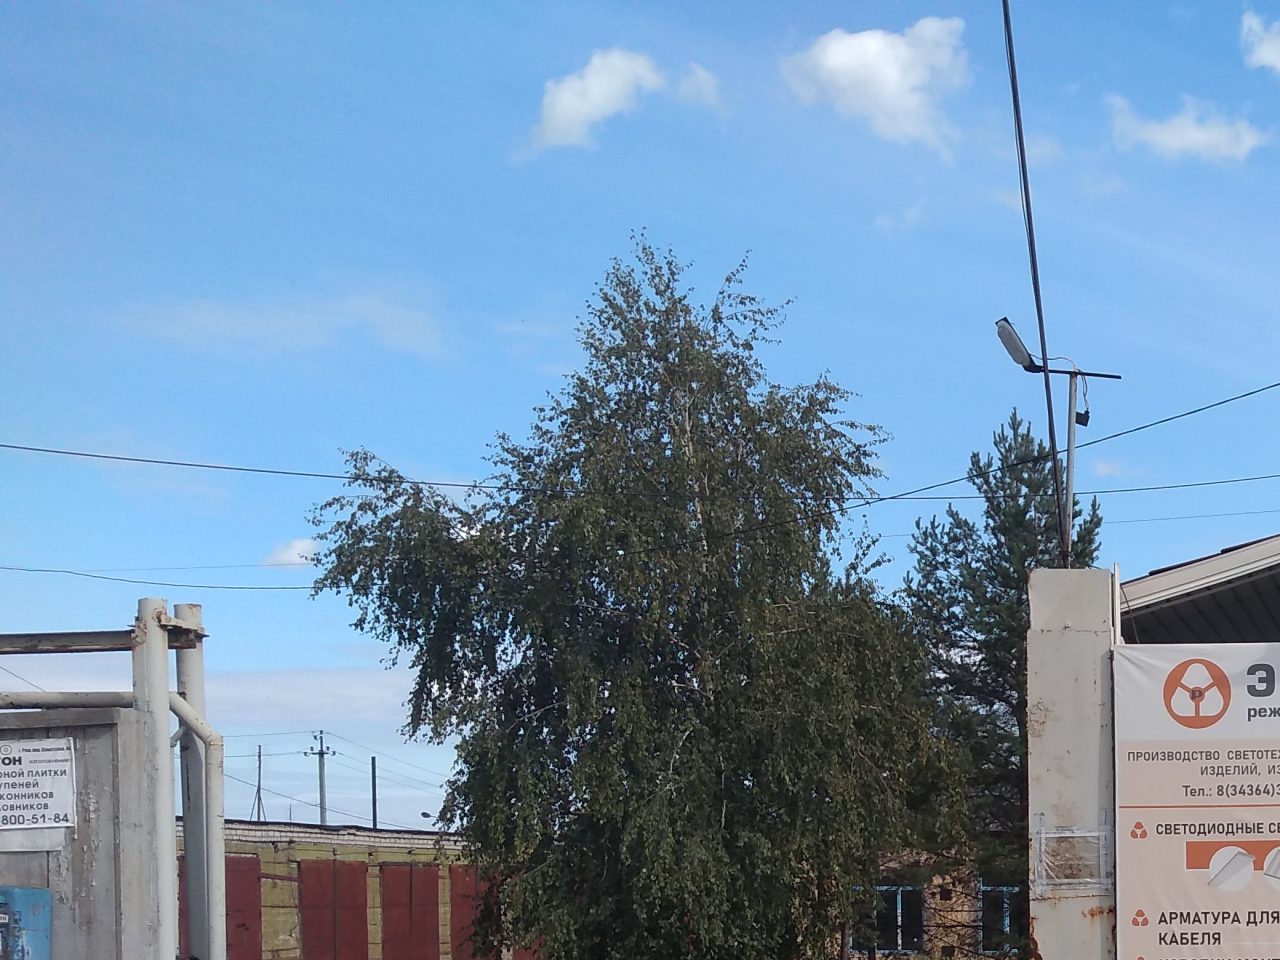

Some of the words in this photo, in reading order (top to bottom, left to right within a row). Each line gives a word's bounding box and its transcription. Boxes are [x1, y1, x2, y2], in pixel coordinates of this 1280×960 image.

[1127, 750, 1220, 762] ПРОИЗВОДСТВО
[1200, 763, 1261, 777] ИЗДЕЛИЙ,
[1182, 784, 1212, 798] Тел.:
[0, 802, 49, 812] овников
[1155, 822, 1264, 836] СВЕТОДИОДНЫЕ
[1158, 911, 1241, 925] АРМАТУРА
[1246, 911, 1280, 927] ДЛЯ
[1158, 932, 1221, 946] КАБЕЛЯ
